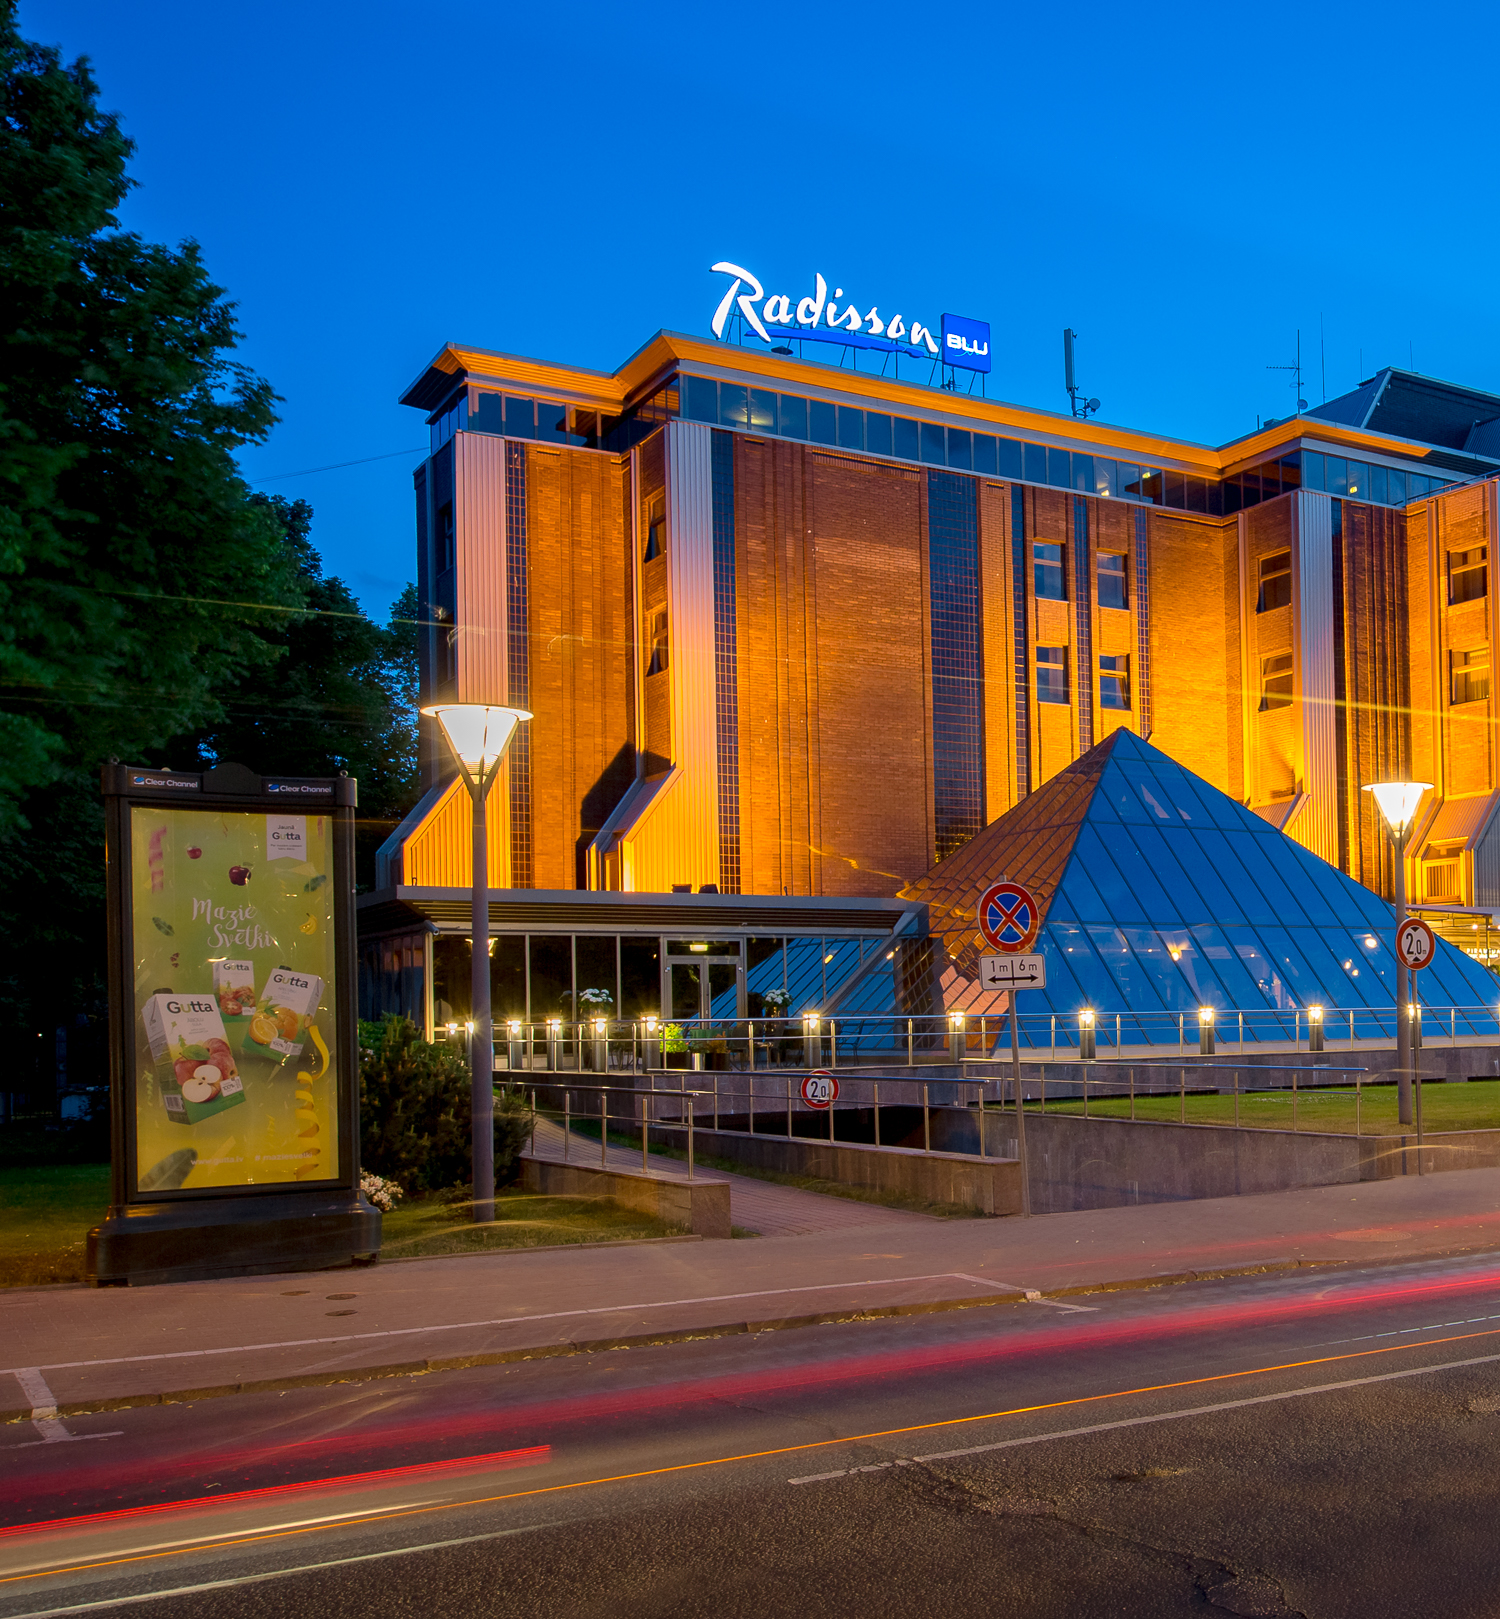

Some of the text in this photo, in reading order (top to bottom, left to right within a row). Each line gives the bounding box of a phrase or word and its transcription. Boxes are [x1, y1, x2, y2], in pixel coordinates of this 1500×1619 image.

[709, 261, 939, 353] Radisson
[946, 333, 989, 356] BLU
[145, 778, 198, 788] Clear Channel
[279, 785, 332, 794] Clear Channel
[272, 831, 302, 841] Gutta
[192, 897, 258, 931] Mazie
[207, 924, 273, 950] Svētki
[223, 963, 250, 971] Gutta
[991, 960, 1008, 972] 1 m
[1019, 959, 1037, 971] 6 m
[273, 974, 309, 989] Gutta
[166, 1001, 214, 1014] Gutta
